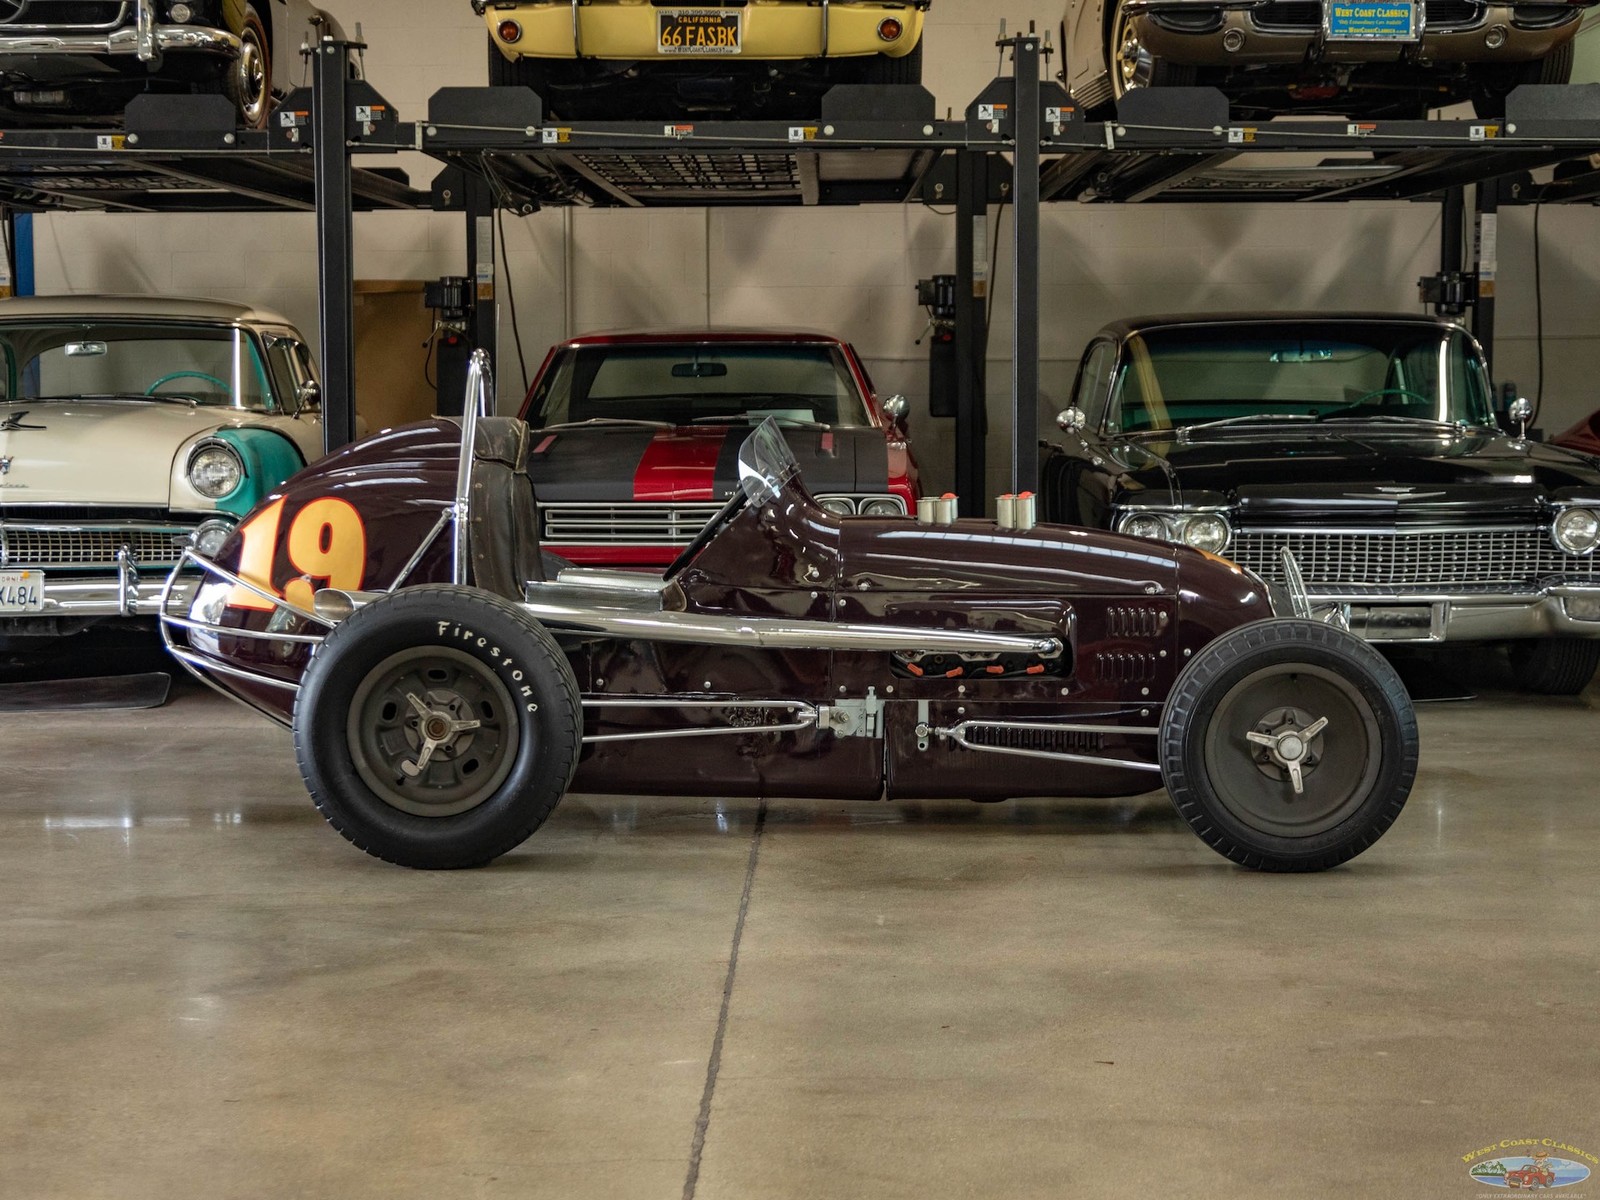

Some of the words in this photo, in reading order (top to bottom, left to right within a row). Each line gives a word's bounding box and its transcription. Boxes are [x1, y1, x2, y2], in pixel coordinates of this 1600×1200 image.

[662, 26, 682, 46] 66
[686, 26, 737, 46] FASBK
[1335, 8, 1353, 17] WEST
[1354, 8, 1375, 17] COAST
[1376, 8, 1408, 18] CLASSICS
[226, 494, 367, 612] 19
[437, 620, 539, 713] Firestone
